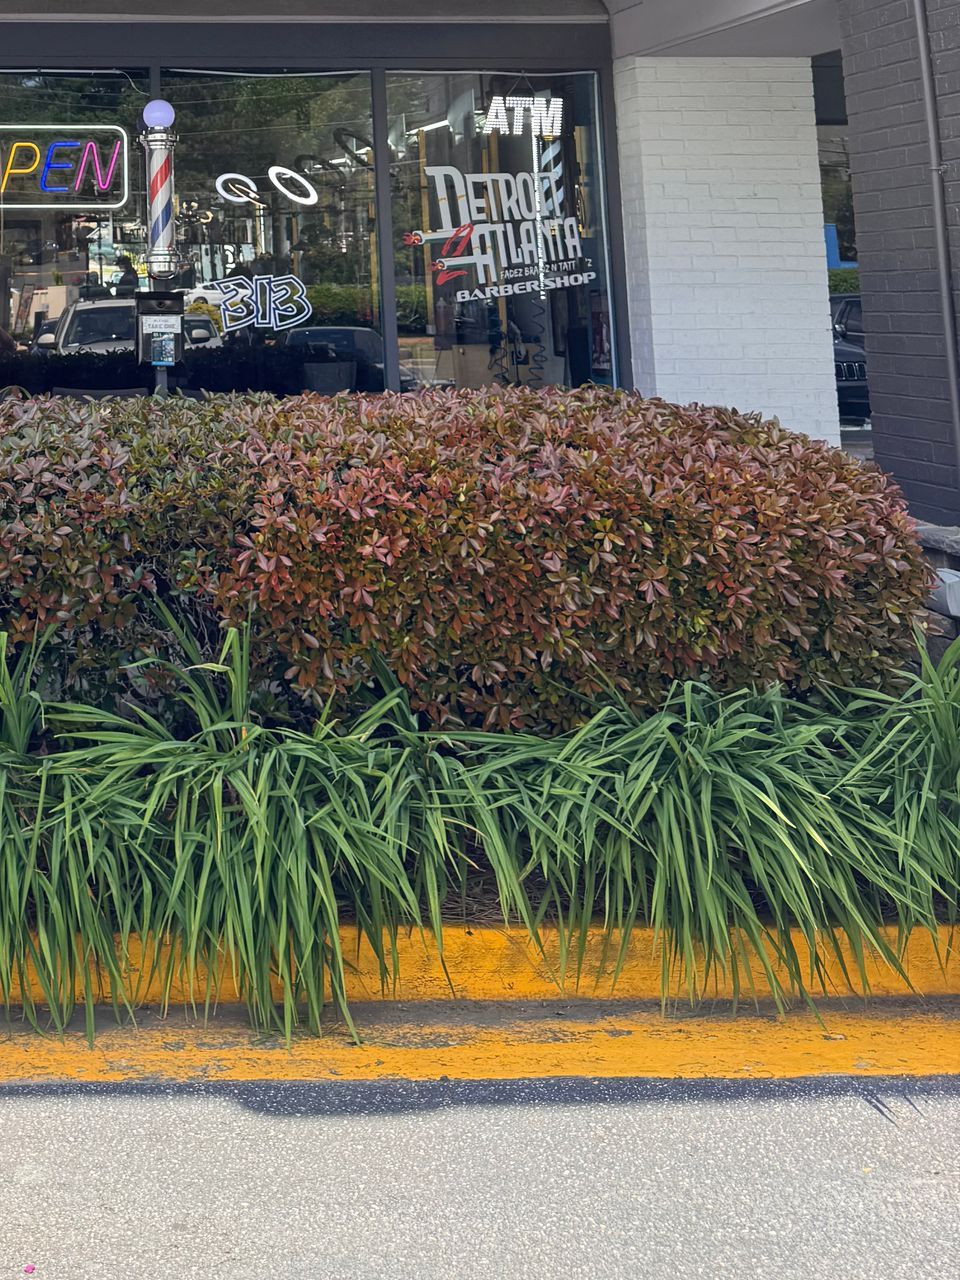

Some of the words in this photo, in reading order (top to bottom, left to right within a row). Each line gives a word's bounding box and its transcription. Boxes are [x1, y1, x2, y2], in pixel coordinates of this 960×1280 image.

[482, 96, 564, 137] ATM
[470, 217, 583, 285] ATLANTA
[500, 268, 524, 280] FADEZ
[551, 263, 558, 273] N
[213, 274, 312, 331] 313
[456, 280, 541, 303] BARBER
[543, 271, 597, 290] SHOP
